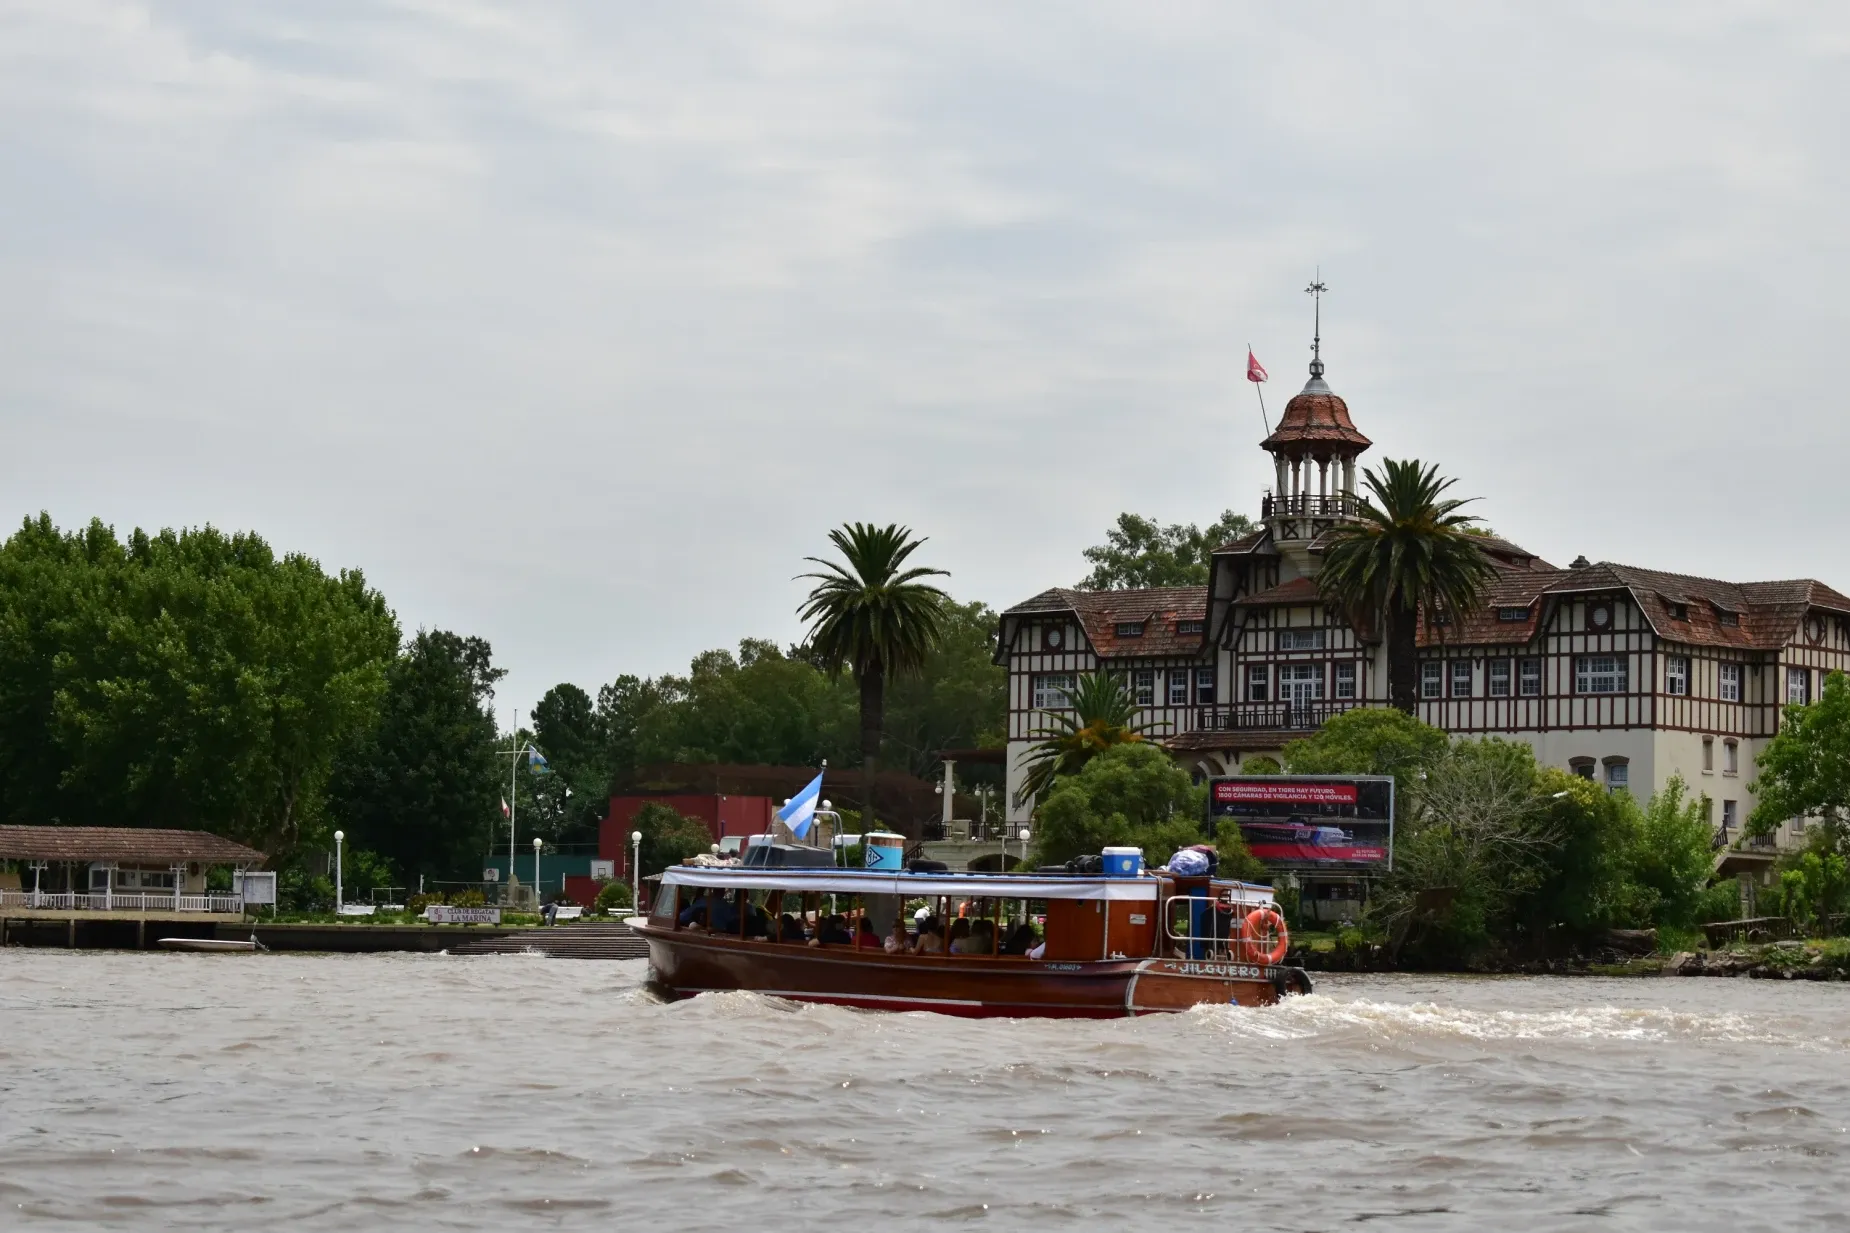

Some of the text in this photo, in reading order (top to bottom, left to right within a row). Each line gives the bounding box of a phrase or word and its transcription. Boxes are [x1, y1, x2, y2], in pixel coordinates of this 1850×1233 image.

[450, 914, 460, 922] LA
[461, 914, 492, 922] MARINA
[1180, 962, 1260, 978] JILGUERO
